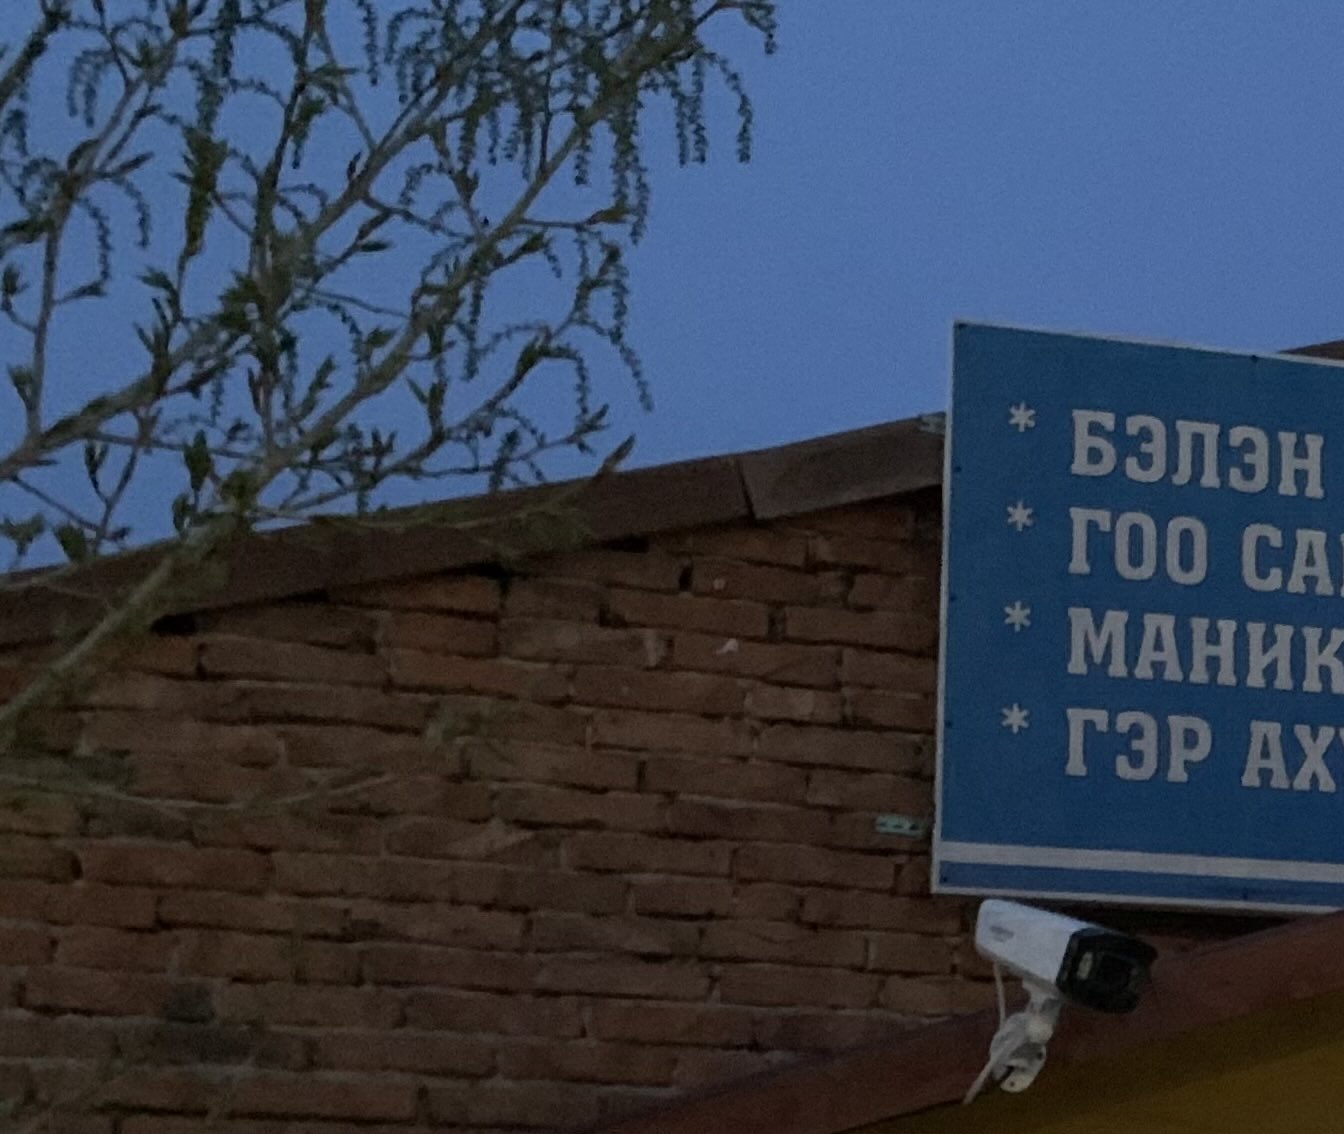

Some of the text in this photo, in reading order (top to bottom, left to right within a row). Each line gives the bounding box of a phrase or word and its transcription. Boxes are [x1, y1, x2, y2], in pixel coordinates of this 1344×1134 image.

[1070, 408, 1325, 500] БЭЛЭН
[1067, 507, 1209, 586] ГОО
[1064, 708, 1213, 783] ГЭР
